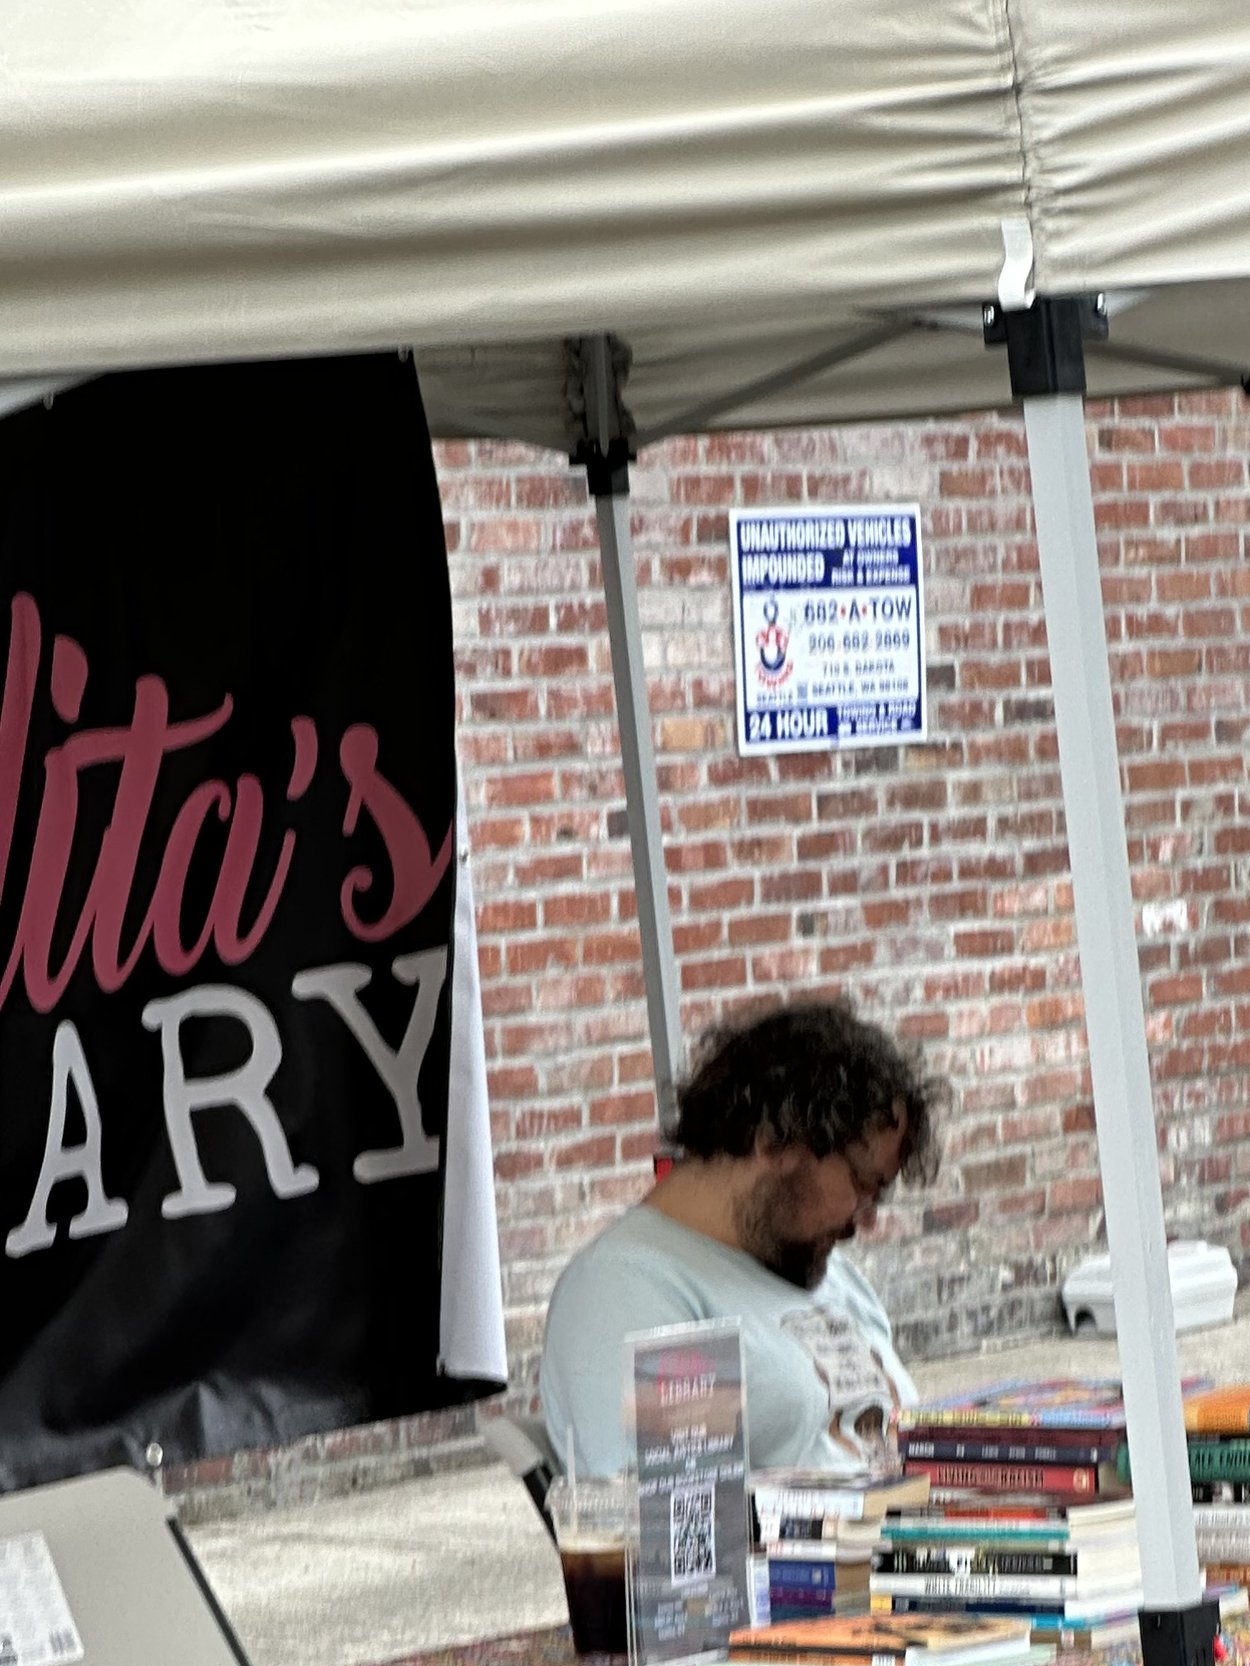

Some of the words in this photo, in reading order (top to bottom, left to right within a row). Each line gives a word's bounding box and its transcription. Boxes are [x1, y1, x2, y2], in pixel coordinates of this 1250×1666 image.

[740, 520, 845, 551] UNAUTHORIZED
[848, 517, 911, 548] VEHICLES
[741, 552, 825, 585] IMPOUNDED
[750, 711, 772, 740] 24
[777, 708, 828, 739] HOUR
[5, 945, 448, 1258] ARY
